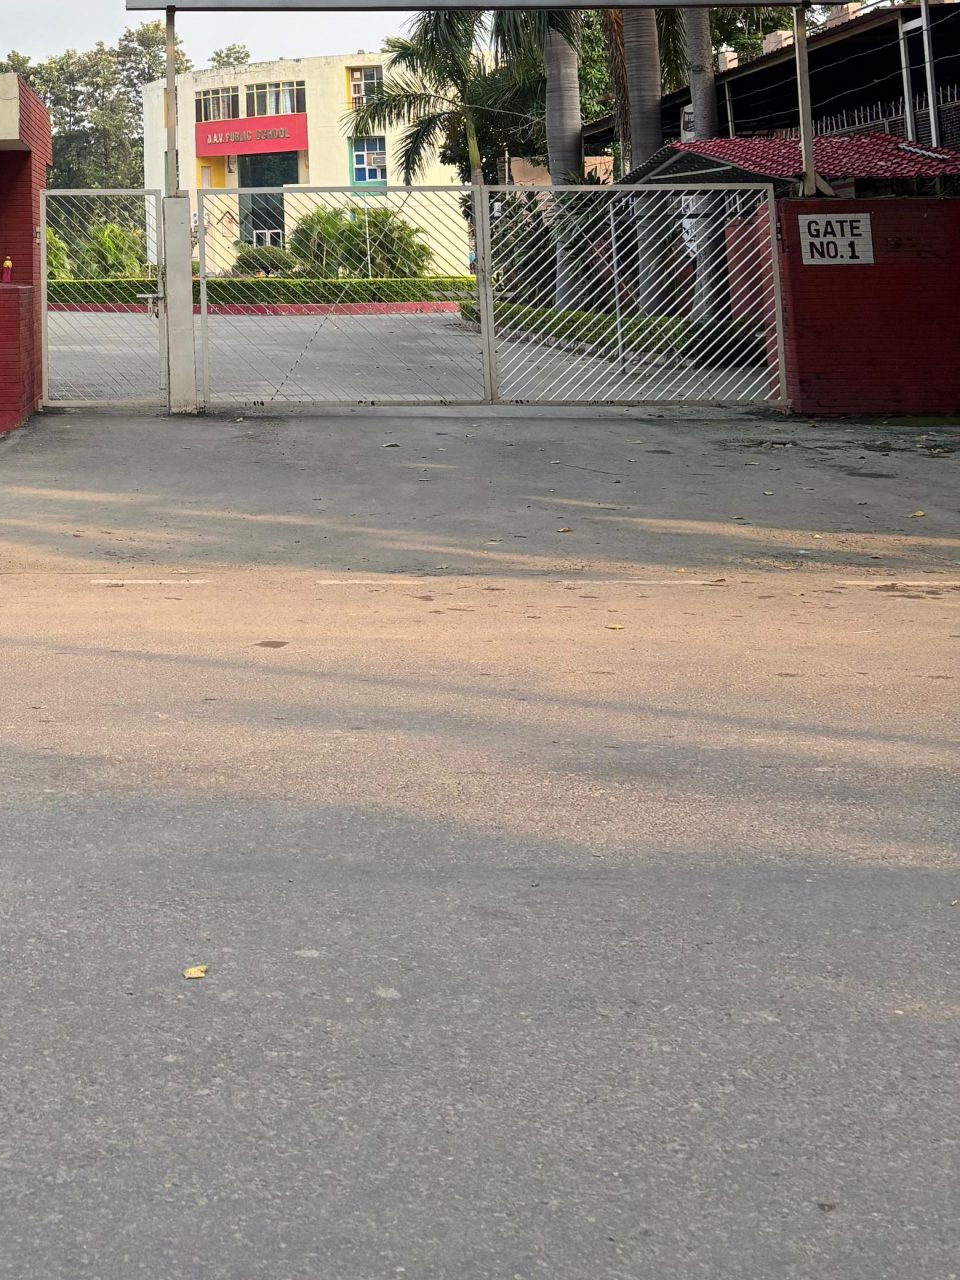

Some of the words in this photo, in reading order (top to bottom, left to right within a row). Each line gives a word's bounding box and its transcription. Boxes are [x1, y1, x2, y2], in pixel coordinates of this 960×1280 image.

[225, 130, 252, 143] PUBLIC
[255, 127, 290, 141] SCHOOL
[807, 219, 863, 238] GATE
